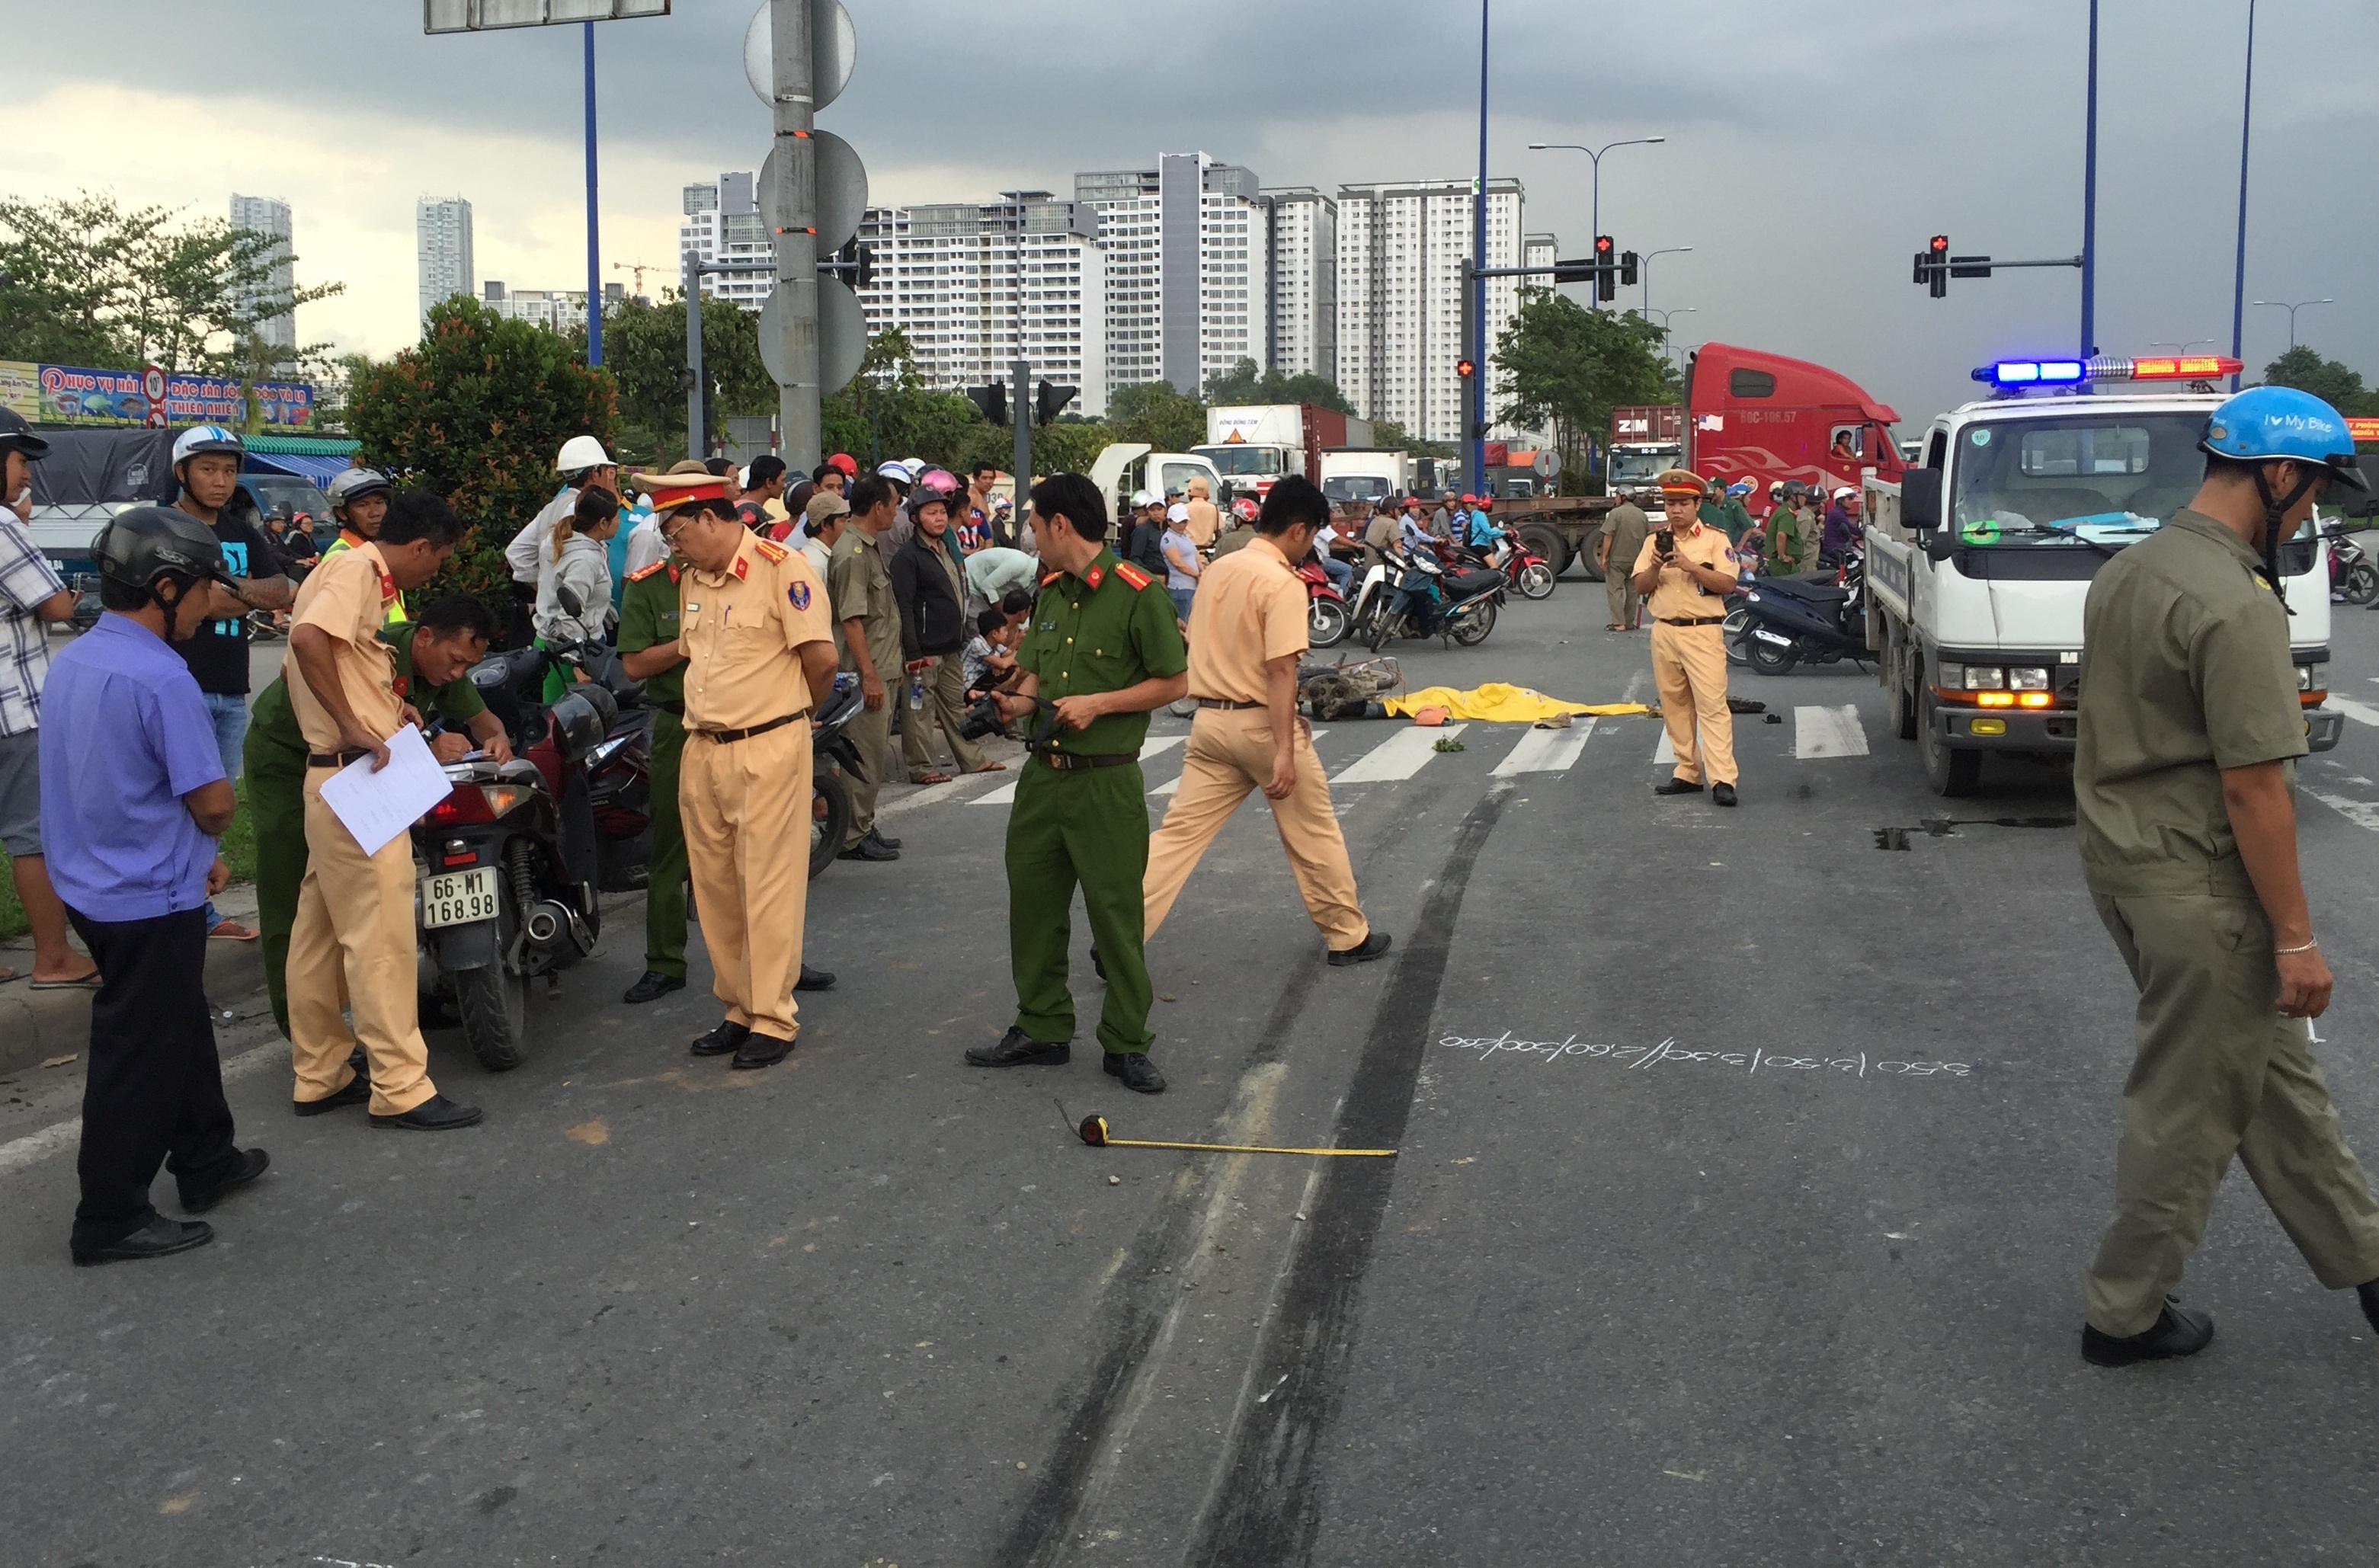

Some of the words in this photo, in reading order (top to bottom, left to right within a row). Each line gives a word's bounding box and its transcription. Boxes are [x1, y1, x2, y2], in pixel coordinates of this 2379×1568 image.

[41, 367, 96, 396] PHỤC
[96, 376, 114, 395] VỤ
[1618, 419, 1648, 434] ZIM
[2285, 414, 2305, 430] My
[2308, 417, 2333, 434] Bike
[427, 894, 494, 924] 168.98
